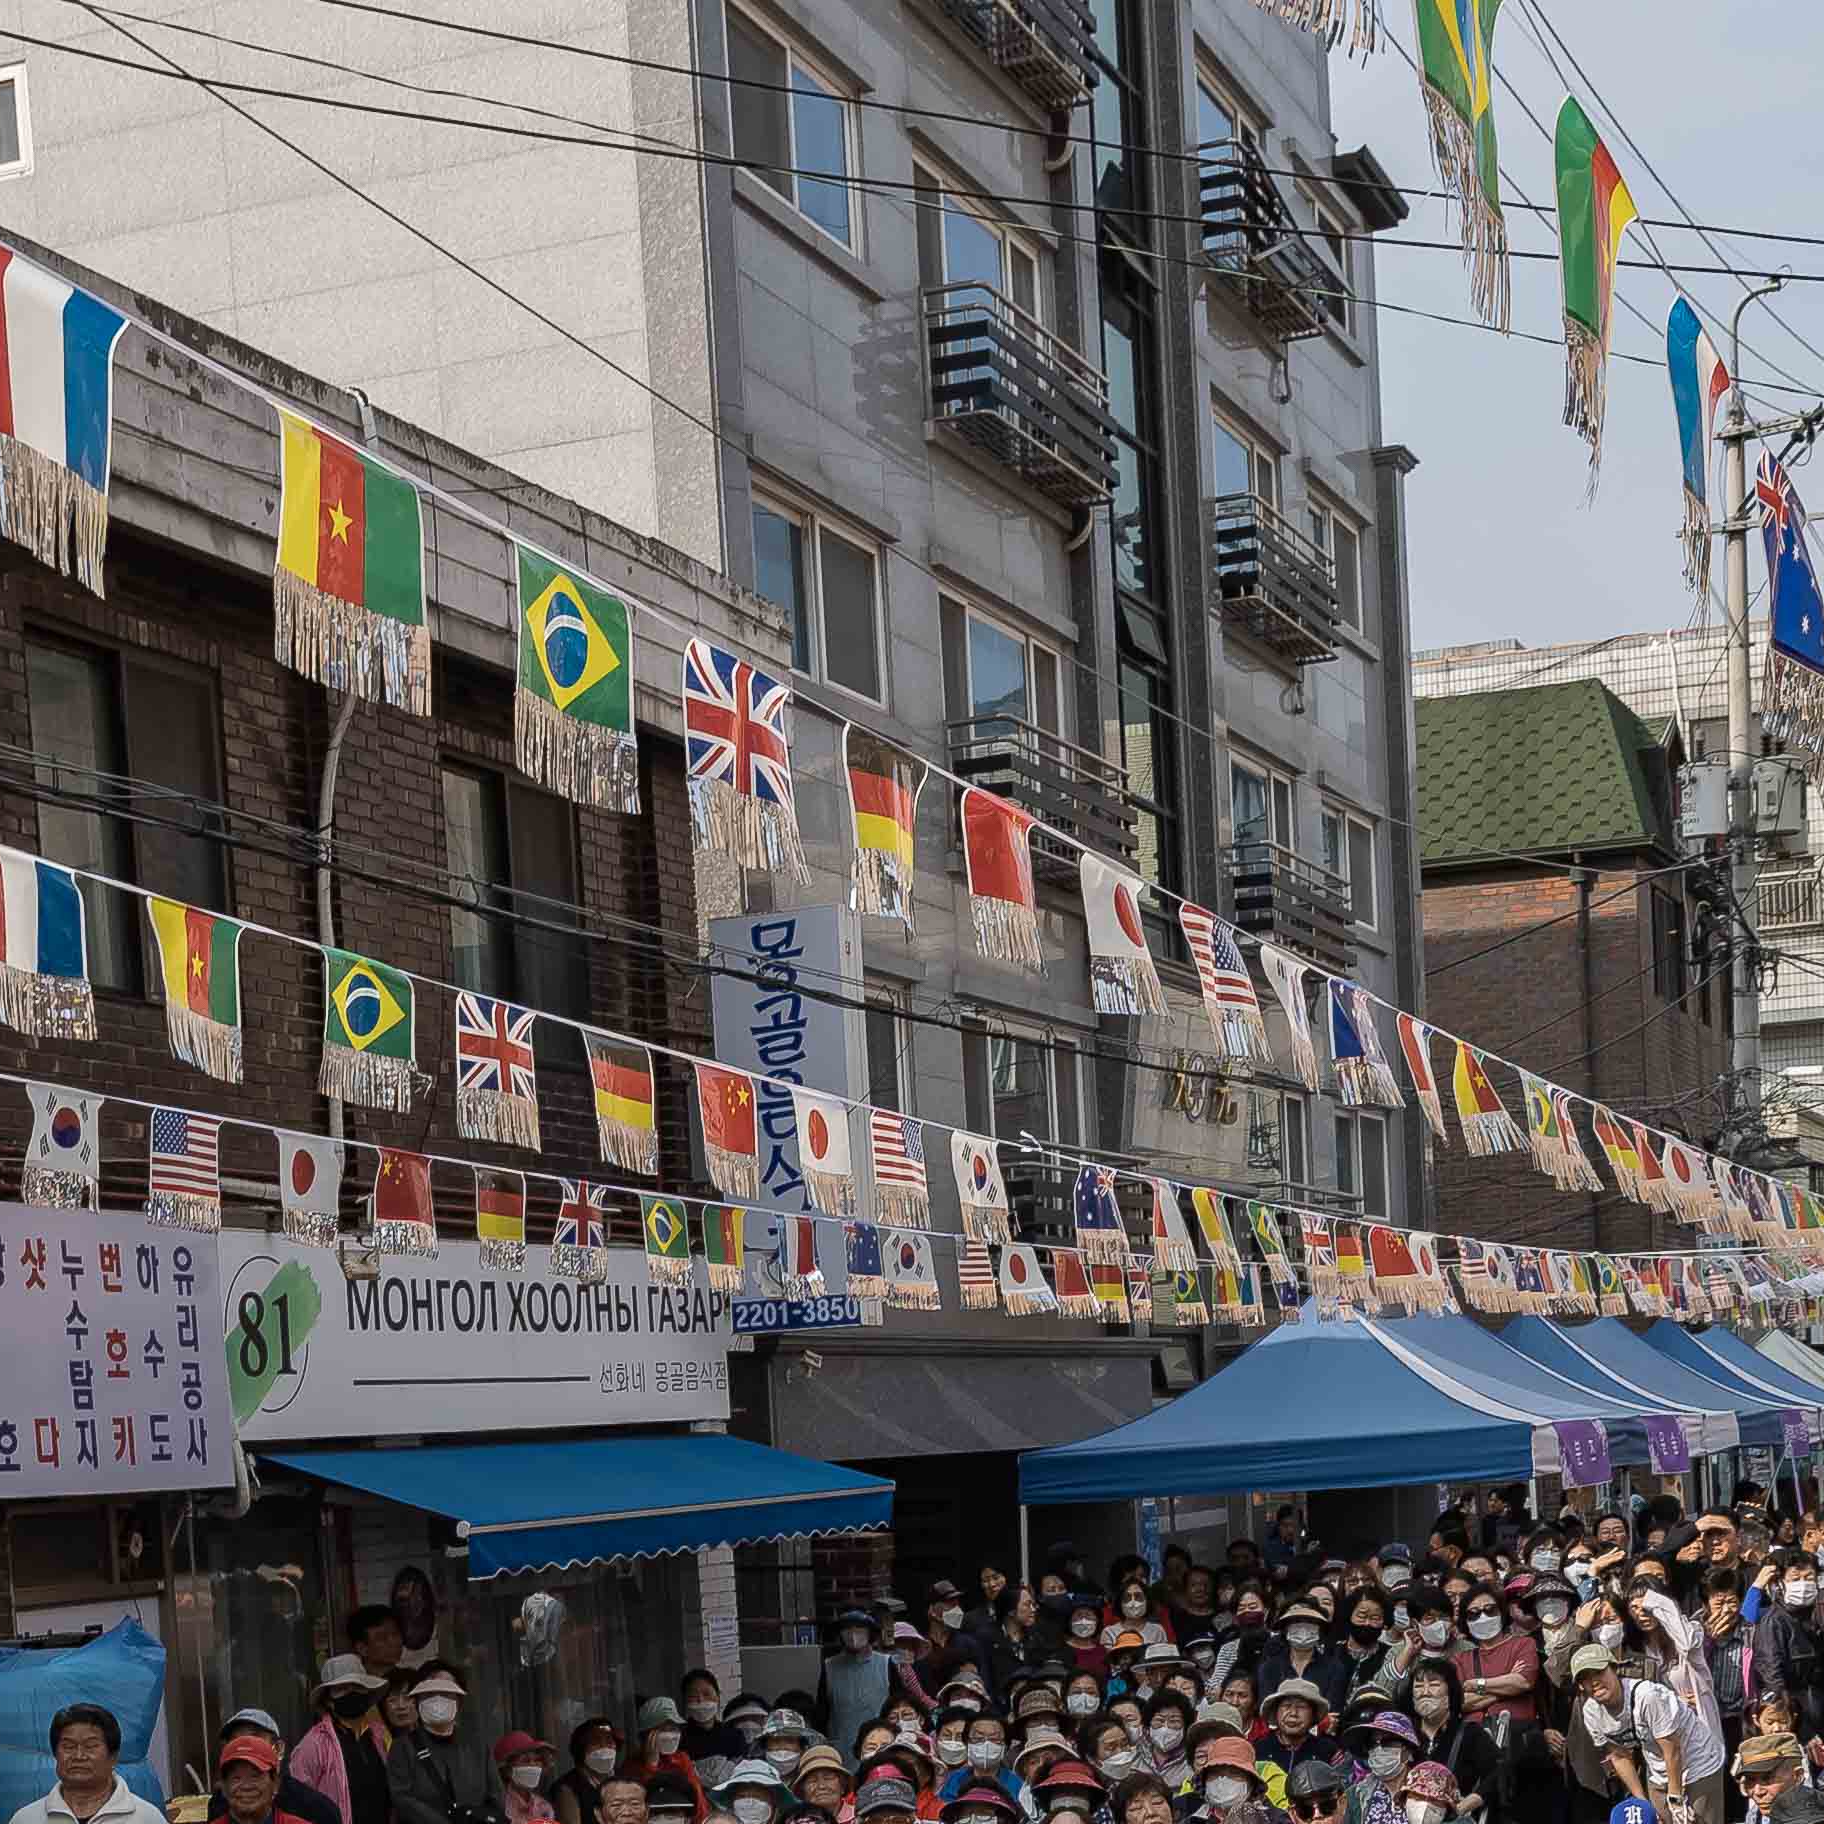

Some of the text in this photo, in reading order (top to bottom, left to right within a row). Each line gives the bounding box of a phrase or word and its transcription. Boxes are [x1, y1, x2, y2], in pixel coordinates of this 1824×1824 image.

[345, 1277, 725, 1335] МОНГОЛ ХООЛНЫ ГАЗАР
[734, 1296, 860, 1330] 2201-3850
[237, 1290, 298, 1378] 81
[598, 1360, 727, 1394] 선화네 몽골음식점
